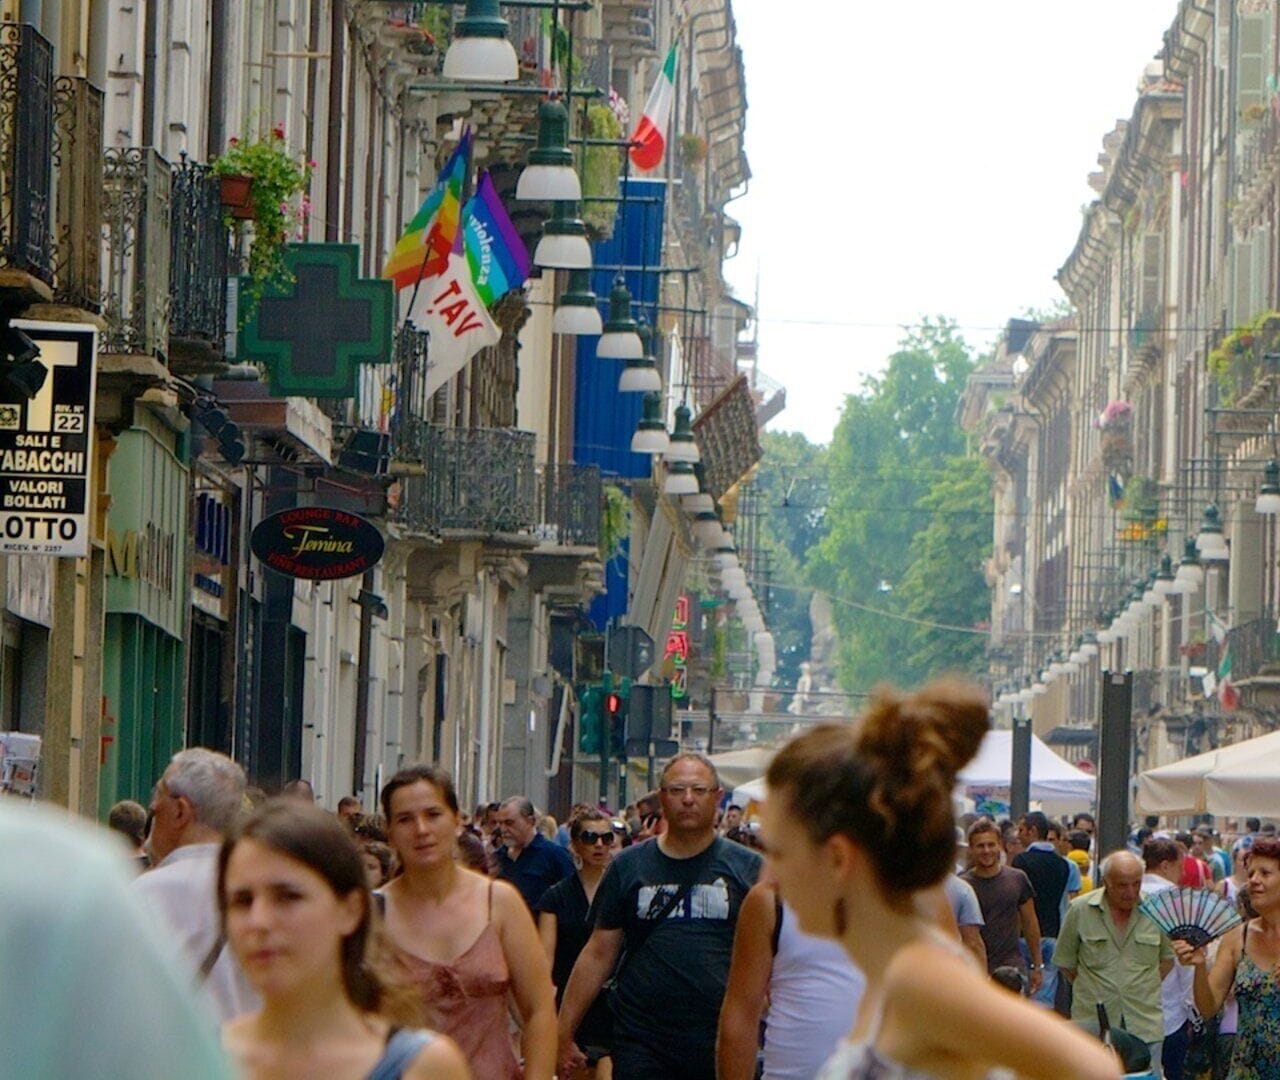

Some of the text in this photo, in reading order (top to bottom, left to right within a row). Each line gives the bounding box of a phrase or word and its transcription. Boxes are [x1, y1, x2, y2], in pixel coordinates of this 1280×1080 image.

[469, 213, 494, 286] violenza
[433, 279, 484, 338] TAV
[58, 415, 81, 431] 22
[15, 434, 61, 448] SALI E
[9, 480, 64, 495] VALORI
[4, 494, 67, 510] BOLLATI
[0, 515, 77, 541] OTTO
